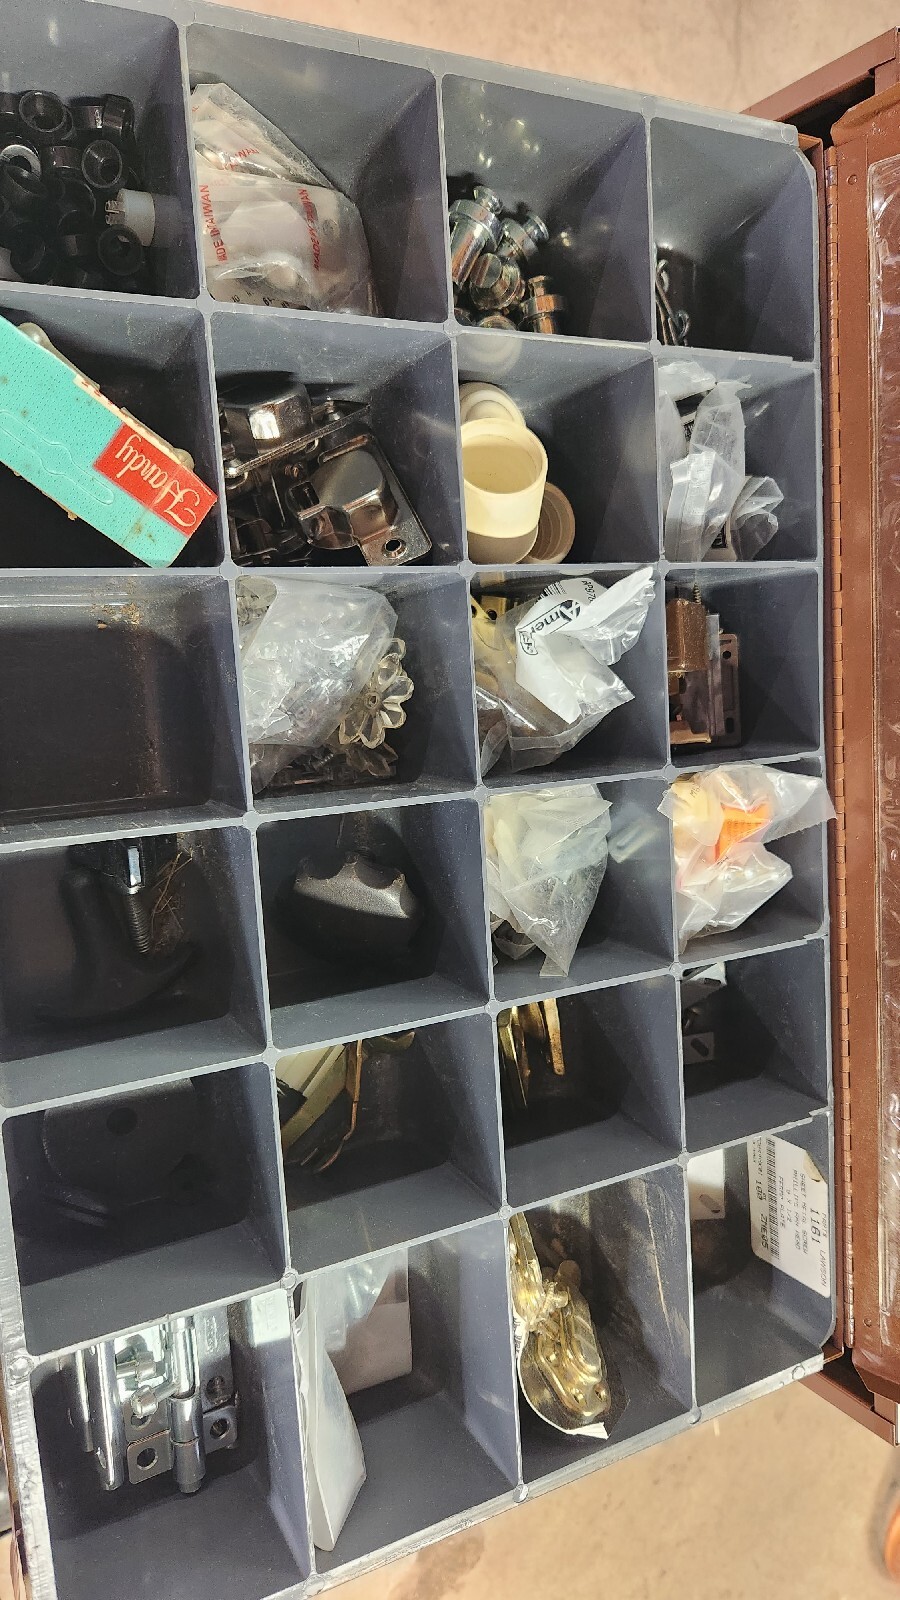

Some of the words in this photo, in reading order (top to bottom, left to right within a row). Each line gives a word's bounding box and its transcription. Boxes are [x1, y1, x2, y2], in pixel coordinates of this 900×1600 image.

[115, 434, 200, 527] Handy
[810, 1208, 821, 1244] 1161
[820, 1249, 828, 1288] LAWSON
